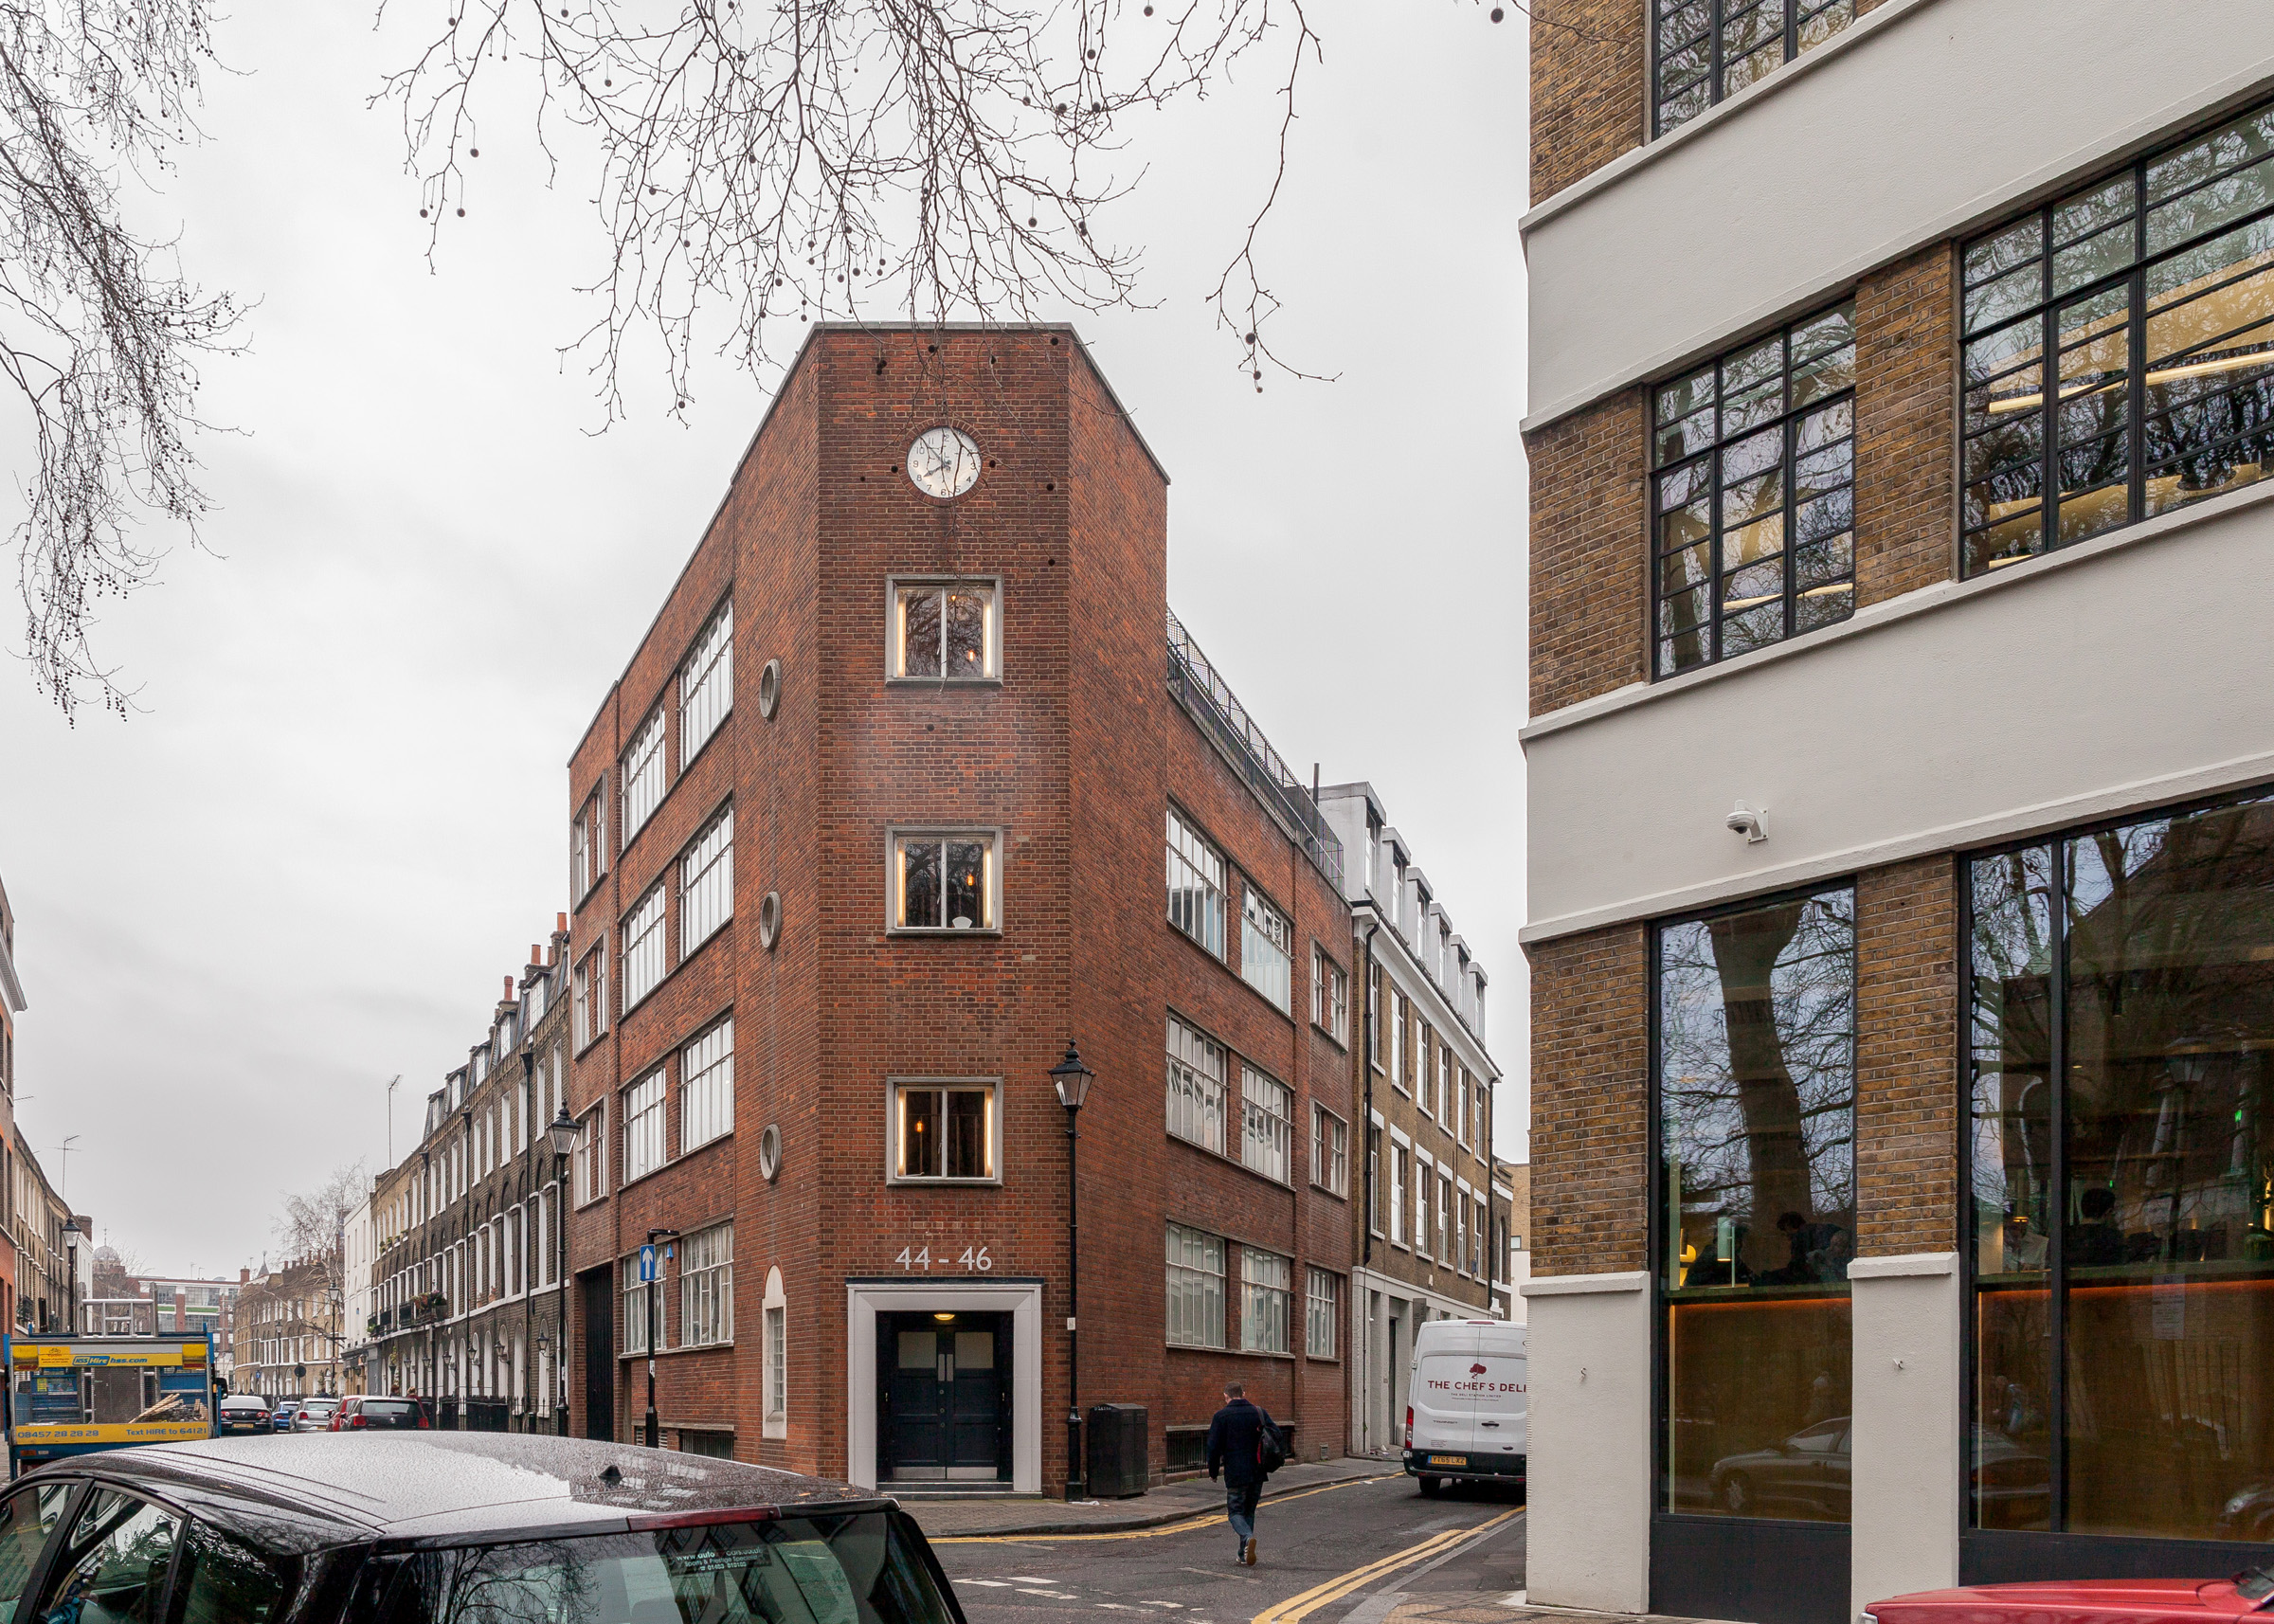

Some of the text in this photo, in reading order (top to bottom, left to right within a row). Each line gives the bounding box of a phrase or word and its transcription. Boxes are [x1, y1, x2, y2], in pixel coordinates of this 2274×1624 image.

[895, 1246, 930, 1271] 44
[958, 1246, 992, 1271] 46
[1428, 1380, 1526, 1393] THE CHEF'S DELI
